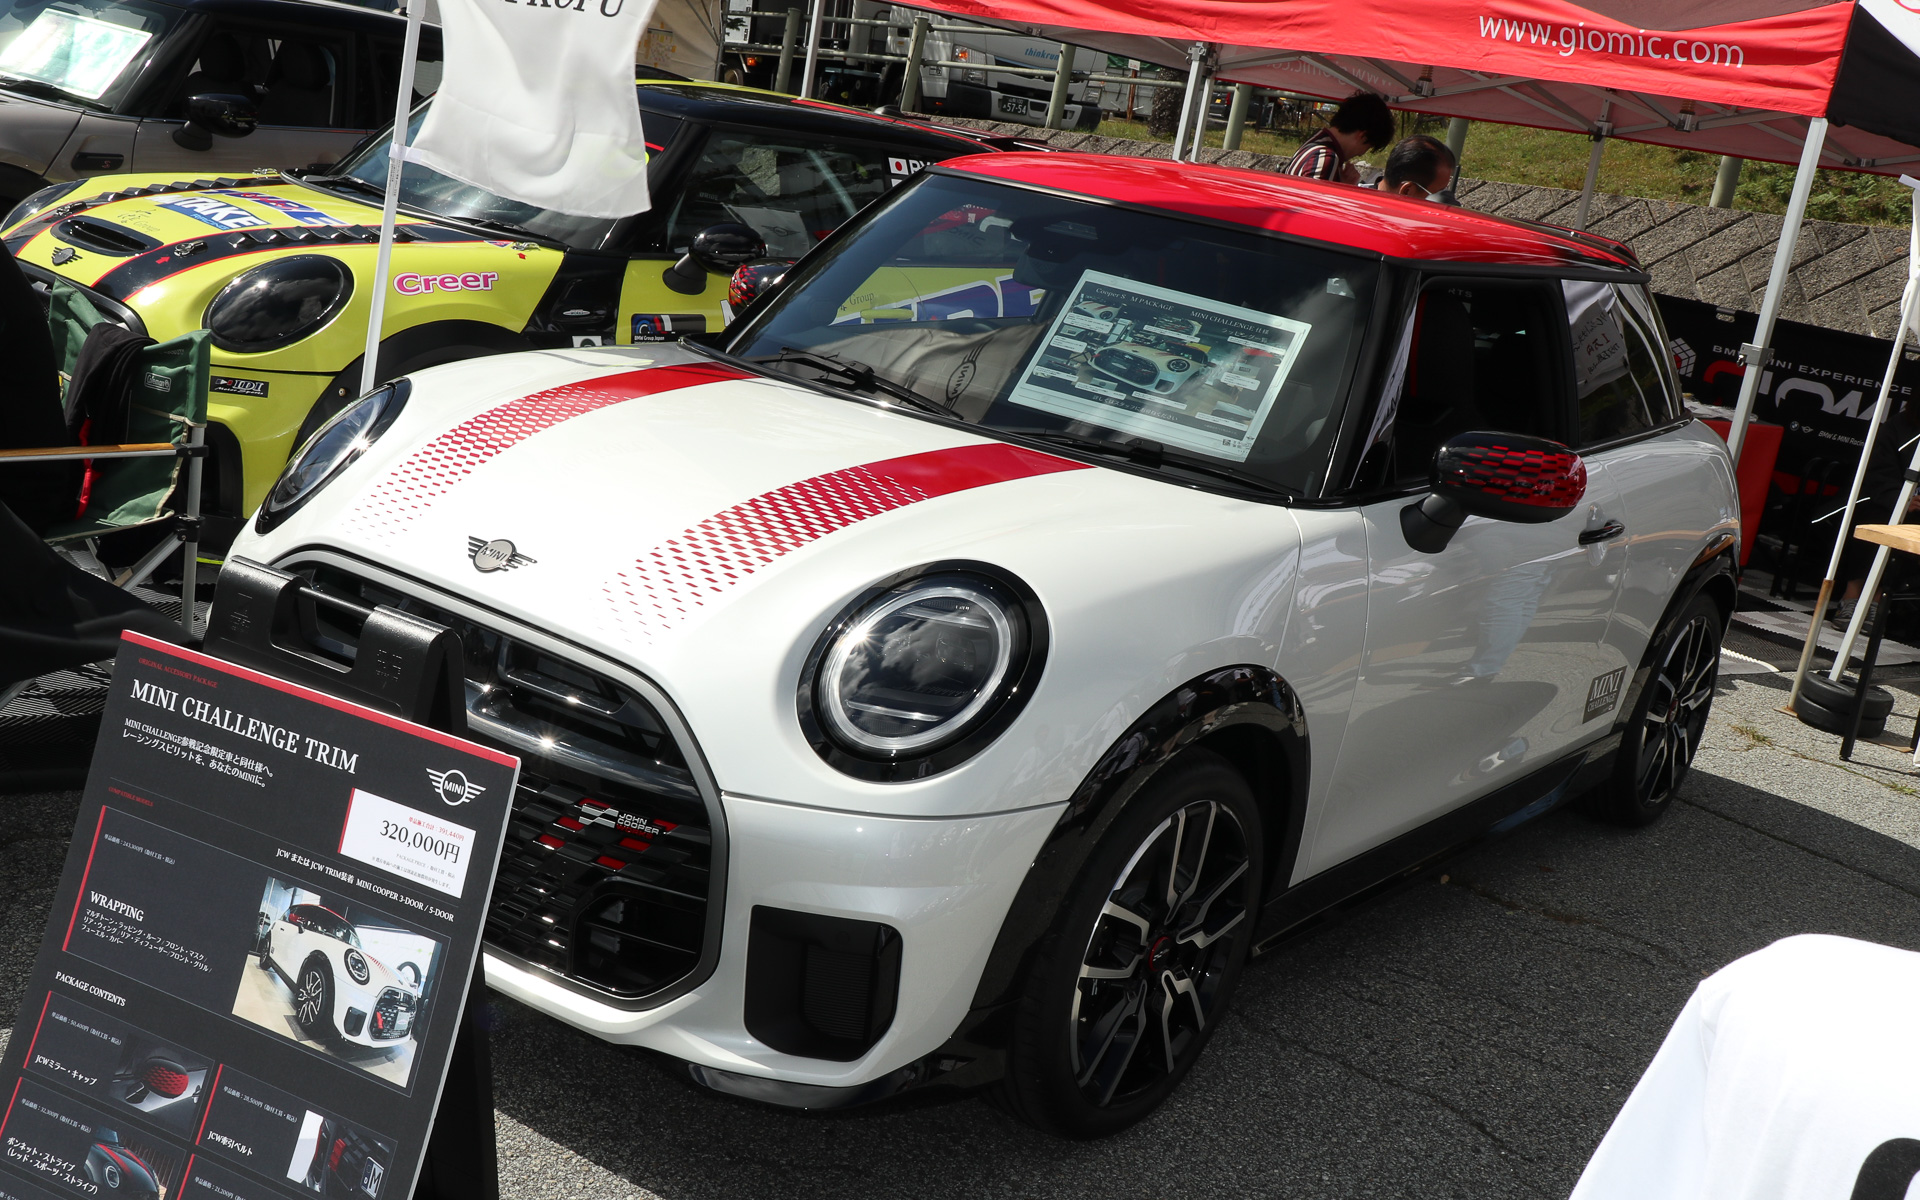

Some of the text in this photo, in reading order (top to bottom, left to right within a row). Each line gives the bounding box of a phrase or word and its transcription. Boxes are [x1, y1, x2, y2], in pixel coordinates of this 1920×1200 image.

[1479, 15, 1744, 68] www.giomic.com
[394, 272, 498, 295] Creer
[1095, 287, 1119, 300] Cooper
[1139, 298, 1174, 311] PACKAGE
[1190, 310, 1204, 320] MINI
[1205, 313, 1255, 333] CHALLENGE
[1713, 345, 1740, 358] BM
[1818, 430, 1832, 441] BMW
[138, 657, 218, 689] ORIGINAL ACCESSORY PACKAGE
[1590, 669, 1623, 701] MINI
[124, 718, 141, 731] MINI
[130, 679, 358, 774] MINI CHALLENGE TRIM
[443, 780, 464, 796] MINI
[617, 818, 659, 835] COOPER
[619, 812, 647, 825] JOHN
[379, 820, 460, 864] 320,000円
[276, 848, 290, 859] JCW
[290, 853, 310, 867] または
[310, 860, 325, 872] JCW
[356, 878, 373, 891] MINI
[373, 884, 398, 901] COOPER
[399, 895, 424, 911] 3-DOOR
[429, 906, 454, 922] 5-DOOR
[91, 891, 144, 921] WRAPPING
[55, 971, 126, 1007] PACKAGE CONTENTS
